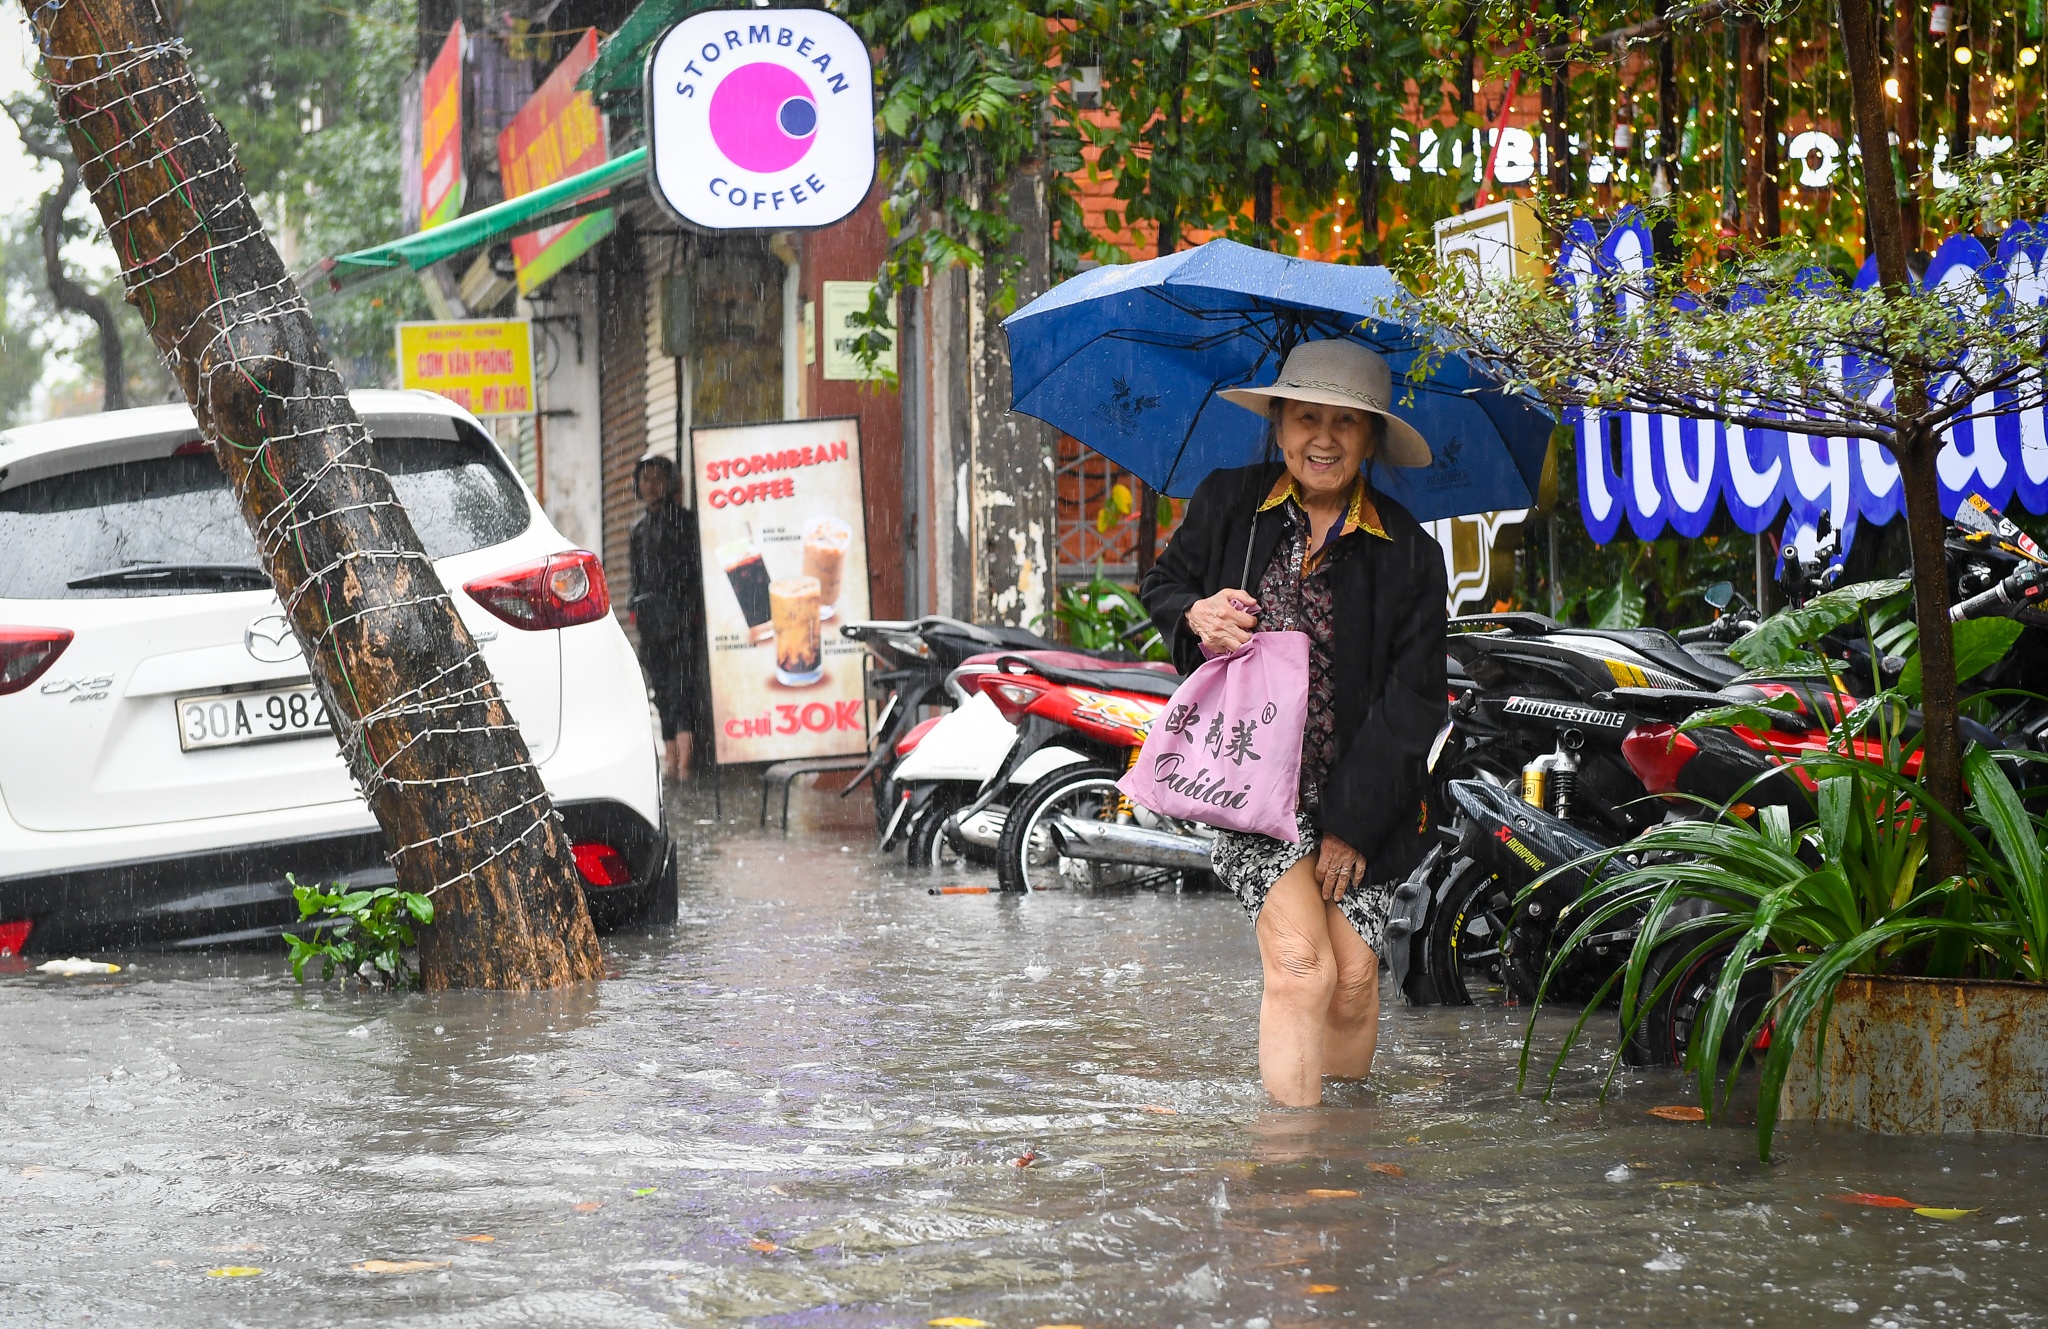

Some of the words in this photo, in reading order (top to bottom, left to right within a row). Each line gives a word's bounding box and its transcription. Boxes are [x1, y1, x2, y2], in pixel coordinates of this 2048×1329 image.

[676, 24, 850, 99] STORMBEAN
[708, 173, 826, 211] COFFEE
[706, 439, 849, 482] STORMBEAN
[708, 477, 795, 510] COFFEE
[40, 672, 115, 695] CX-5
[775, 699, 864, 735] 30K
[1504, 696, 1626, 727] BRIDGESTONE
[1155, 753, 1251, 810] Oulilai
